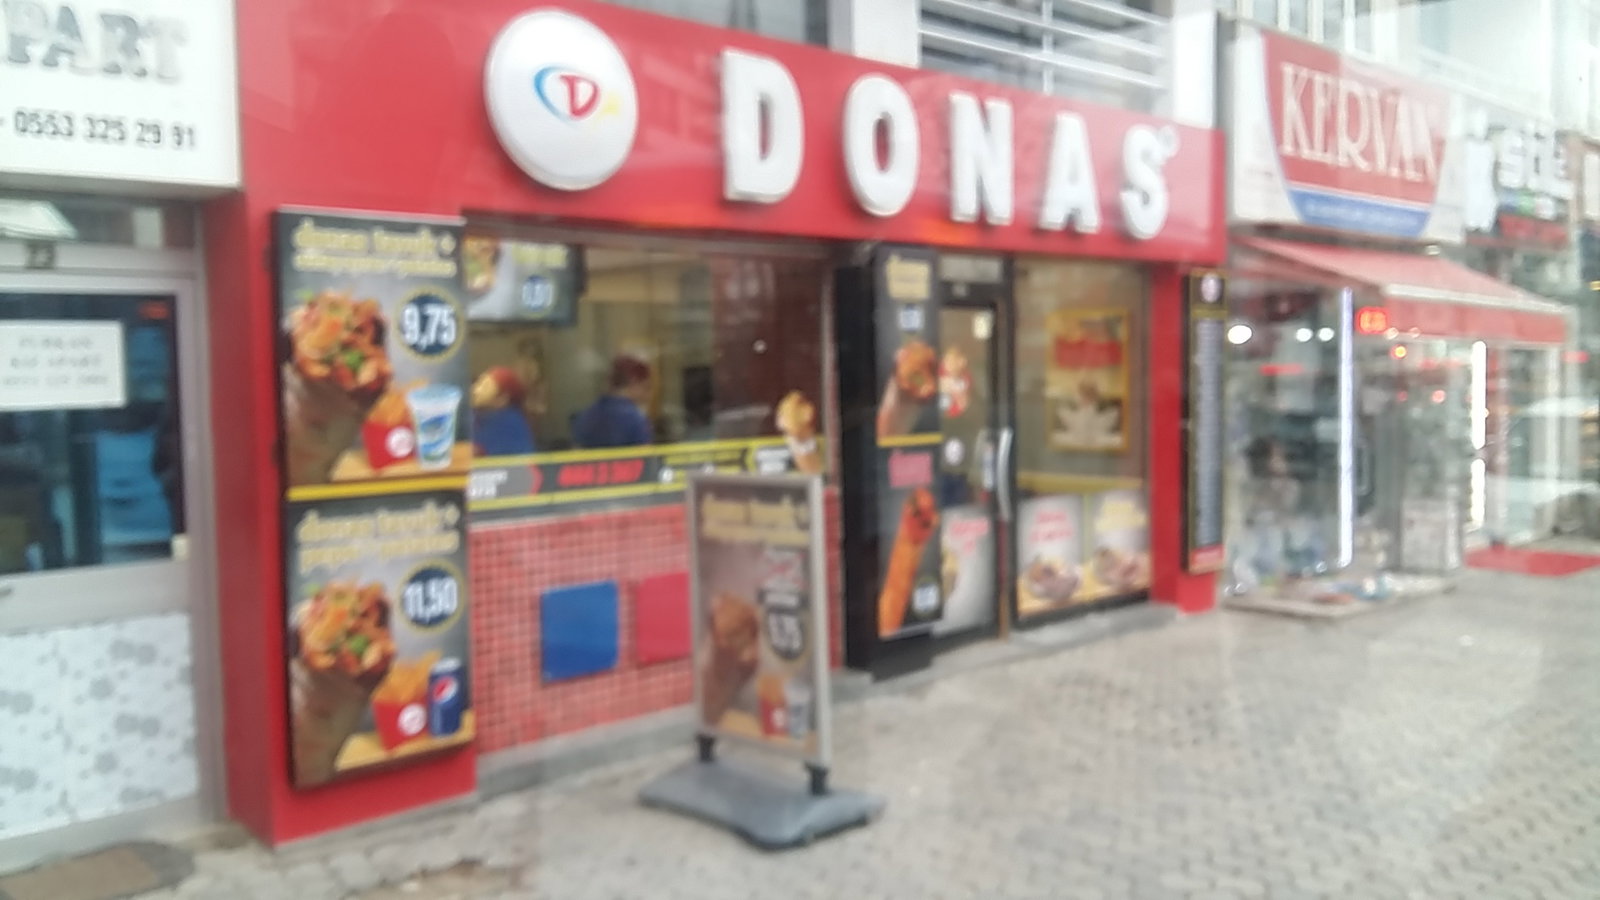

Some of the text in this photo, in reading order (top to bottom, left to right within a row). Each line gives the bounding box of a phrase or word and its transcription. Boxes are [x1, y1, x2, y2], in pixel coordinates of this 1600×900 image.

[721, 49, 1170, 240] DONAS
[404, 302, 457, 350] 9,75
[404, 575, 458, 624] 11,50
